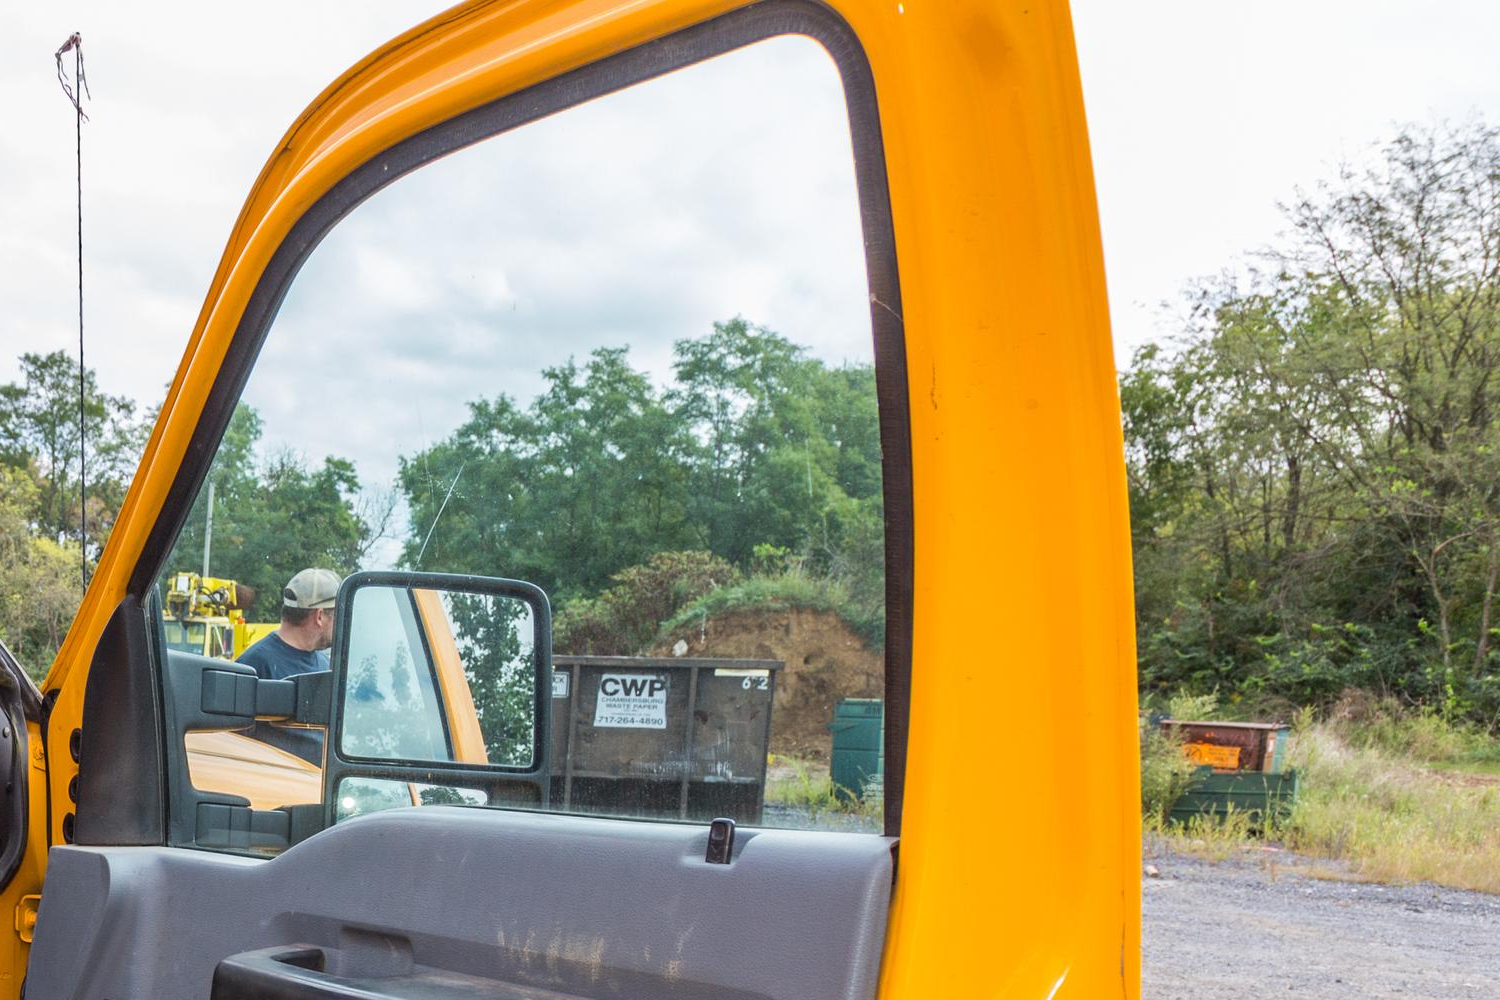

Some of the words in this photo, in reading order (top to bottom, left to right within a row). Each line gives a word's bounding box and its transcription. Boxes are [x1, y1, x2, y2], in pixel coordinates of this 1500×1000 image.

[601, 678, 666, 697] CWP
[742, 676, 768, 690] 62
[598, 716, 664, 726] 717-264-4890
